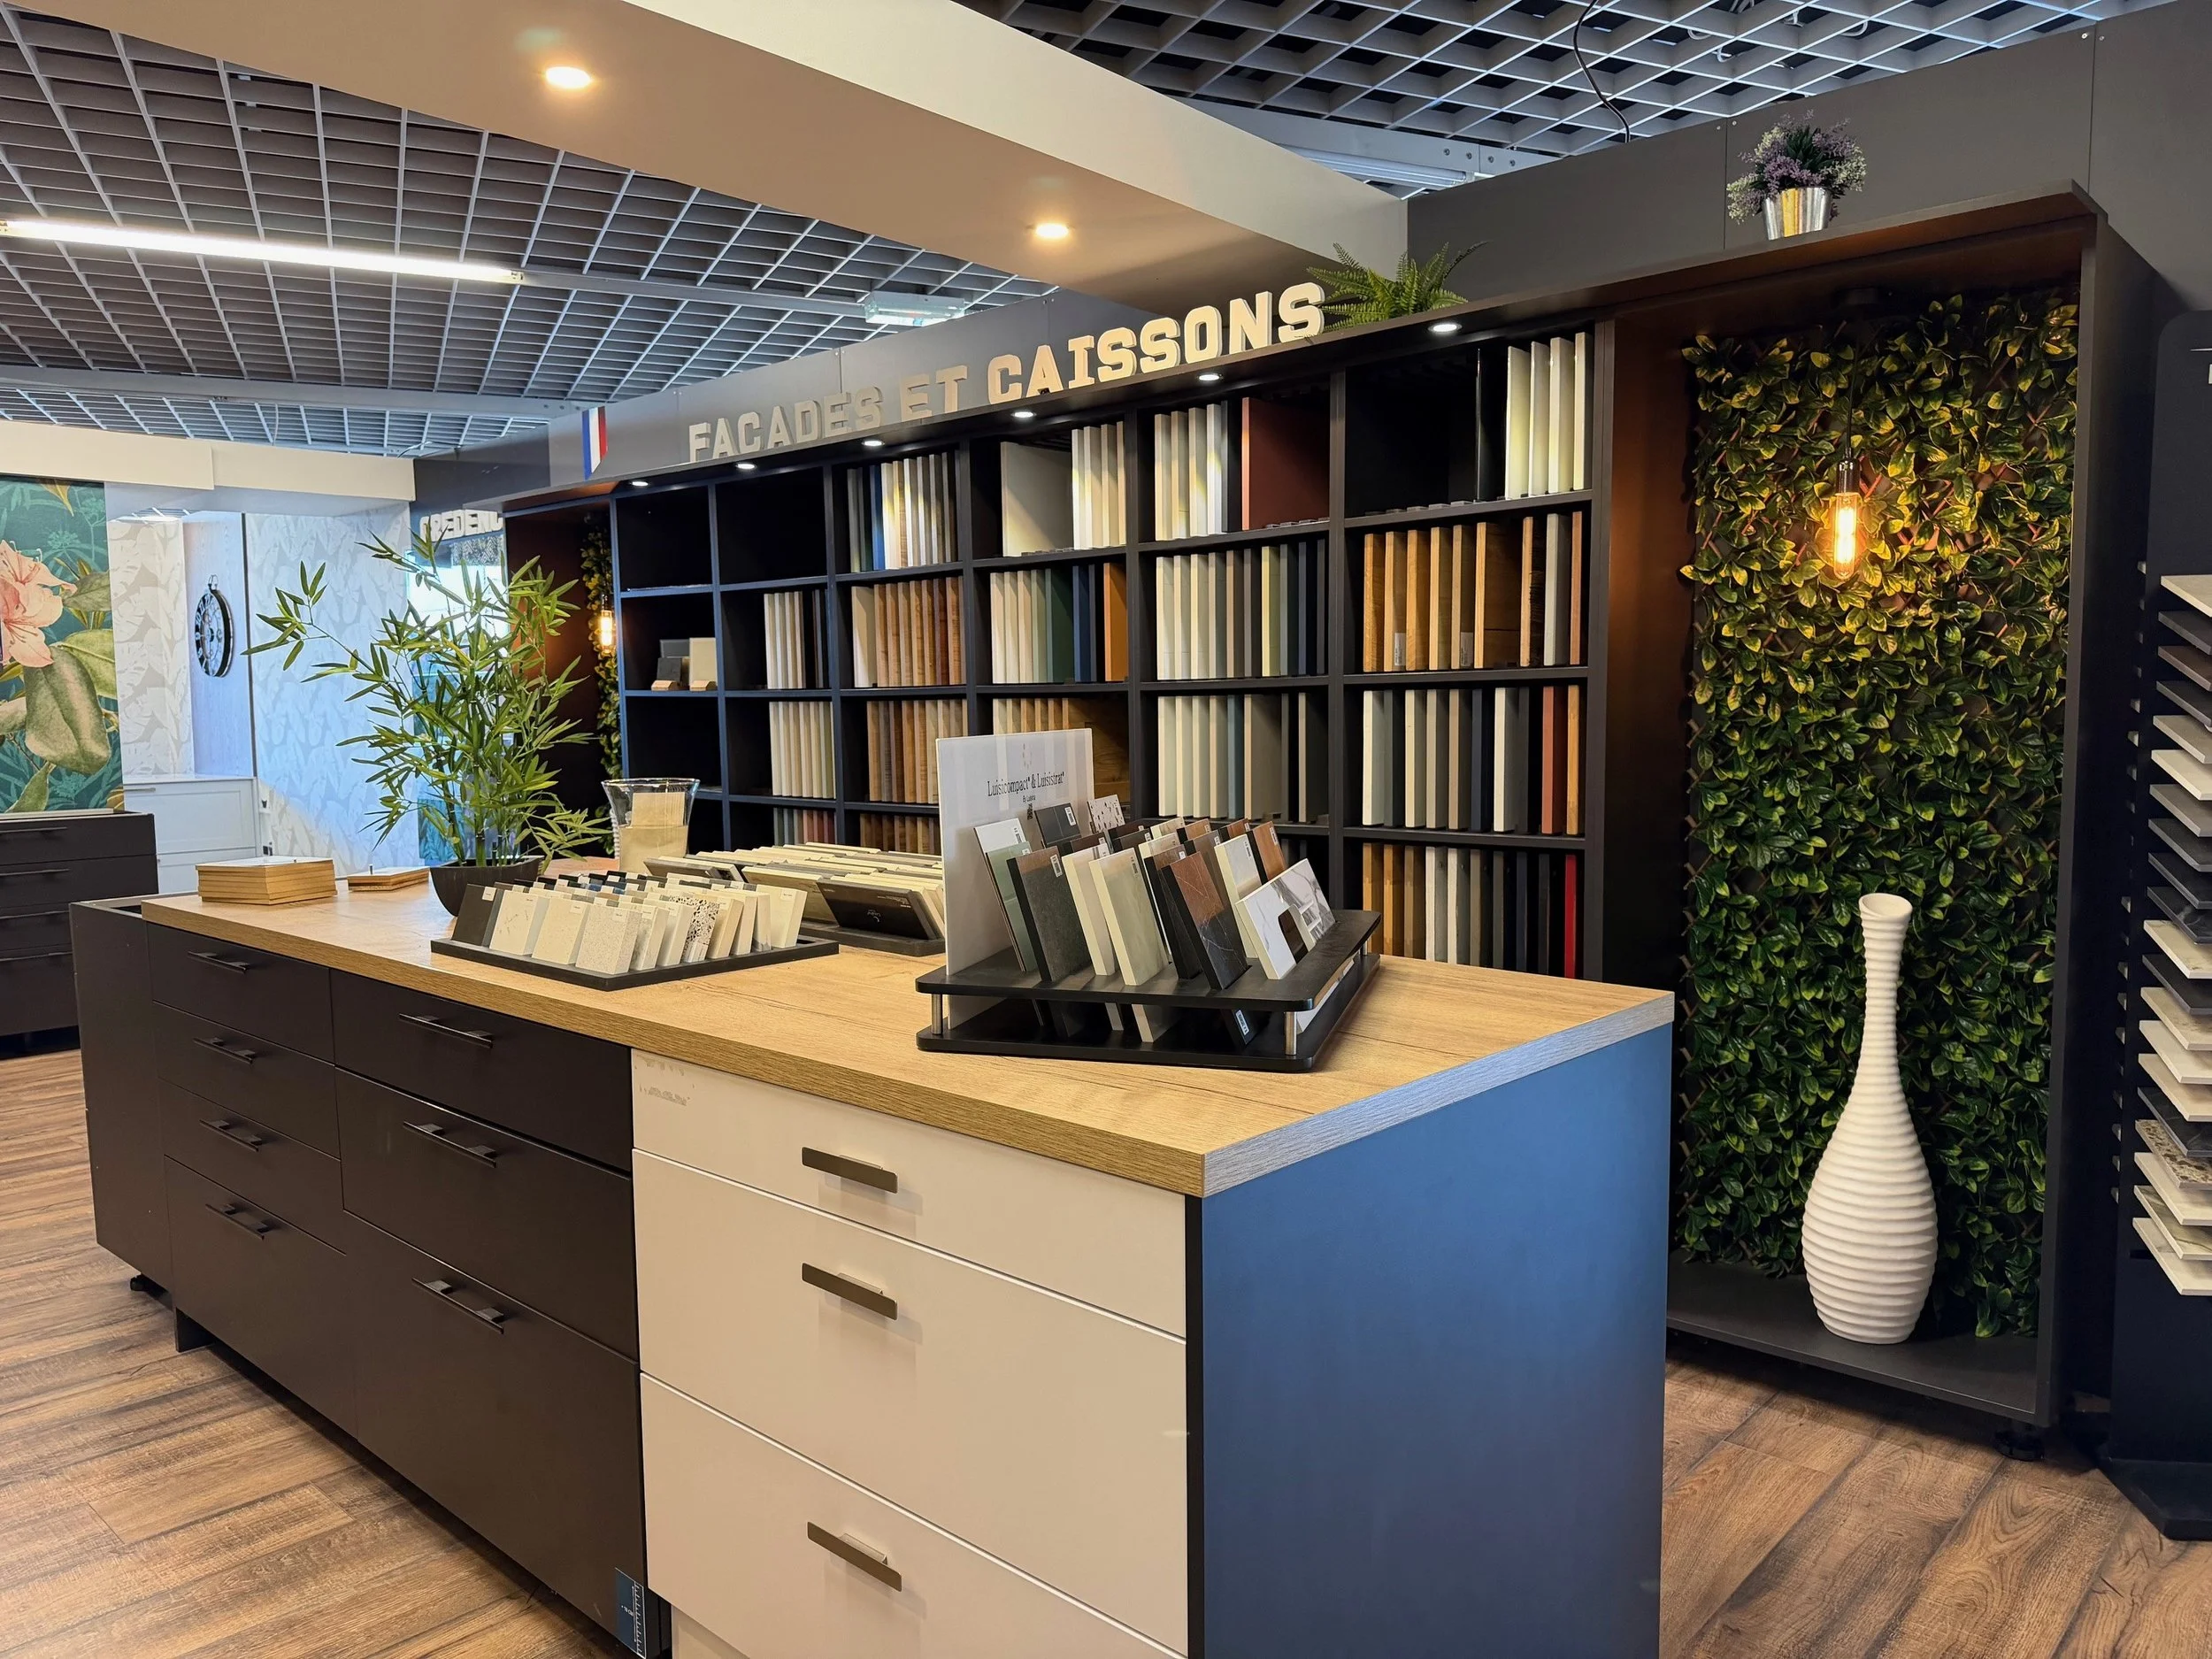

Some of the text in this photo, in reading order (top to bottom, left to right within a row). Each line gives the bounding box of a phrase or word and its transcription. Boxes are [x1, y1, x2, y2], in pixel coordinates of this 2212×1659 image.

[688, 281, 1325, 464] FACADES ET CAISSONS
